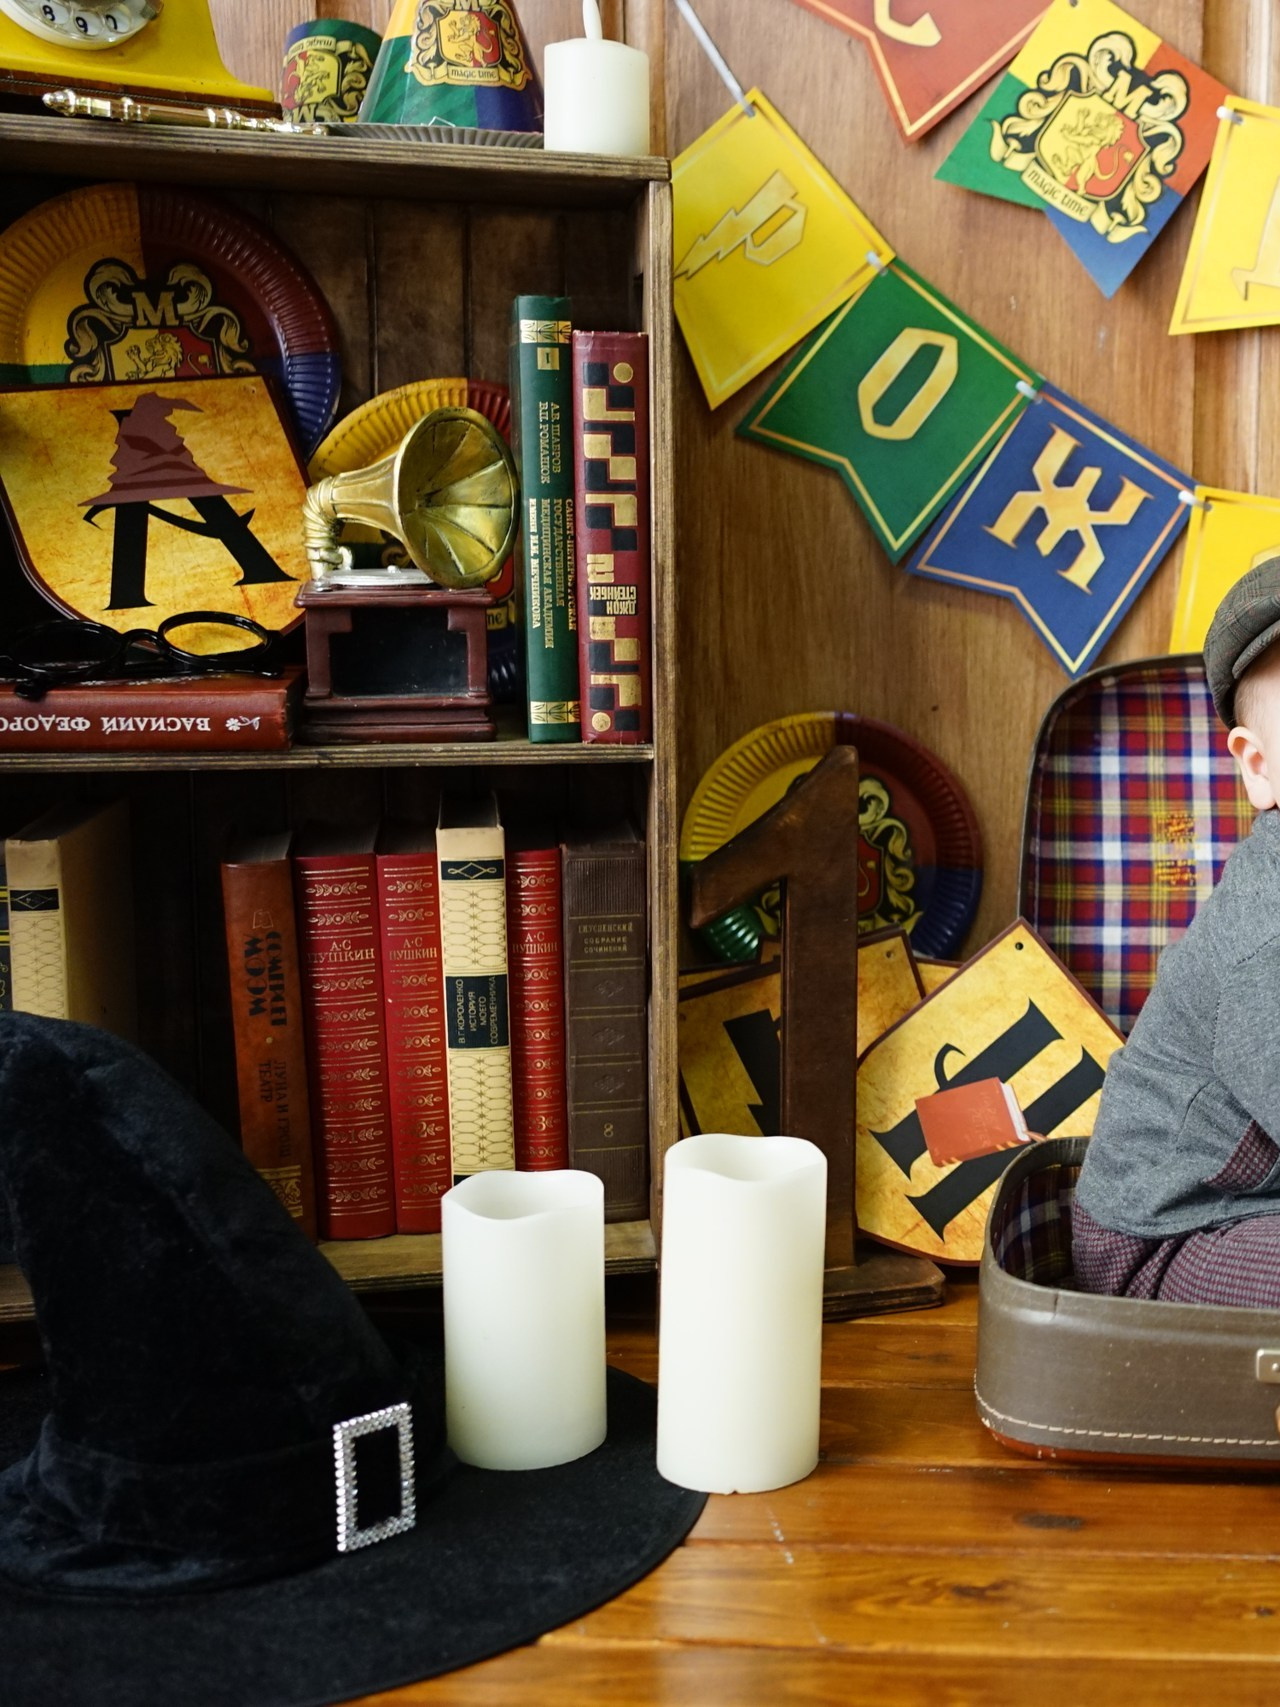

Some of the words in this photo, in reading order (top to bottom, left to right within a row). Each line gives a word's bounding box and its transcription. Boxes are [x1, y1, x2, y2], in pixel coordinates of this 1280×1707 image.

[1102, 70, 1153, 119] M
[606, 600, 636, 615] ДЖОН
[101, 716, 211, 735] ВАСИЛИЙ
[307, 948, 376, 963] ПУШКИН
[389, 947, 438, 960] ПУШКИН
[512, 942, 558, 954] ПУШКИН
[603, 1122, 614, 1137] 8
